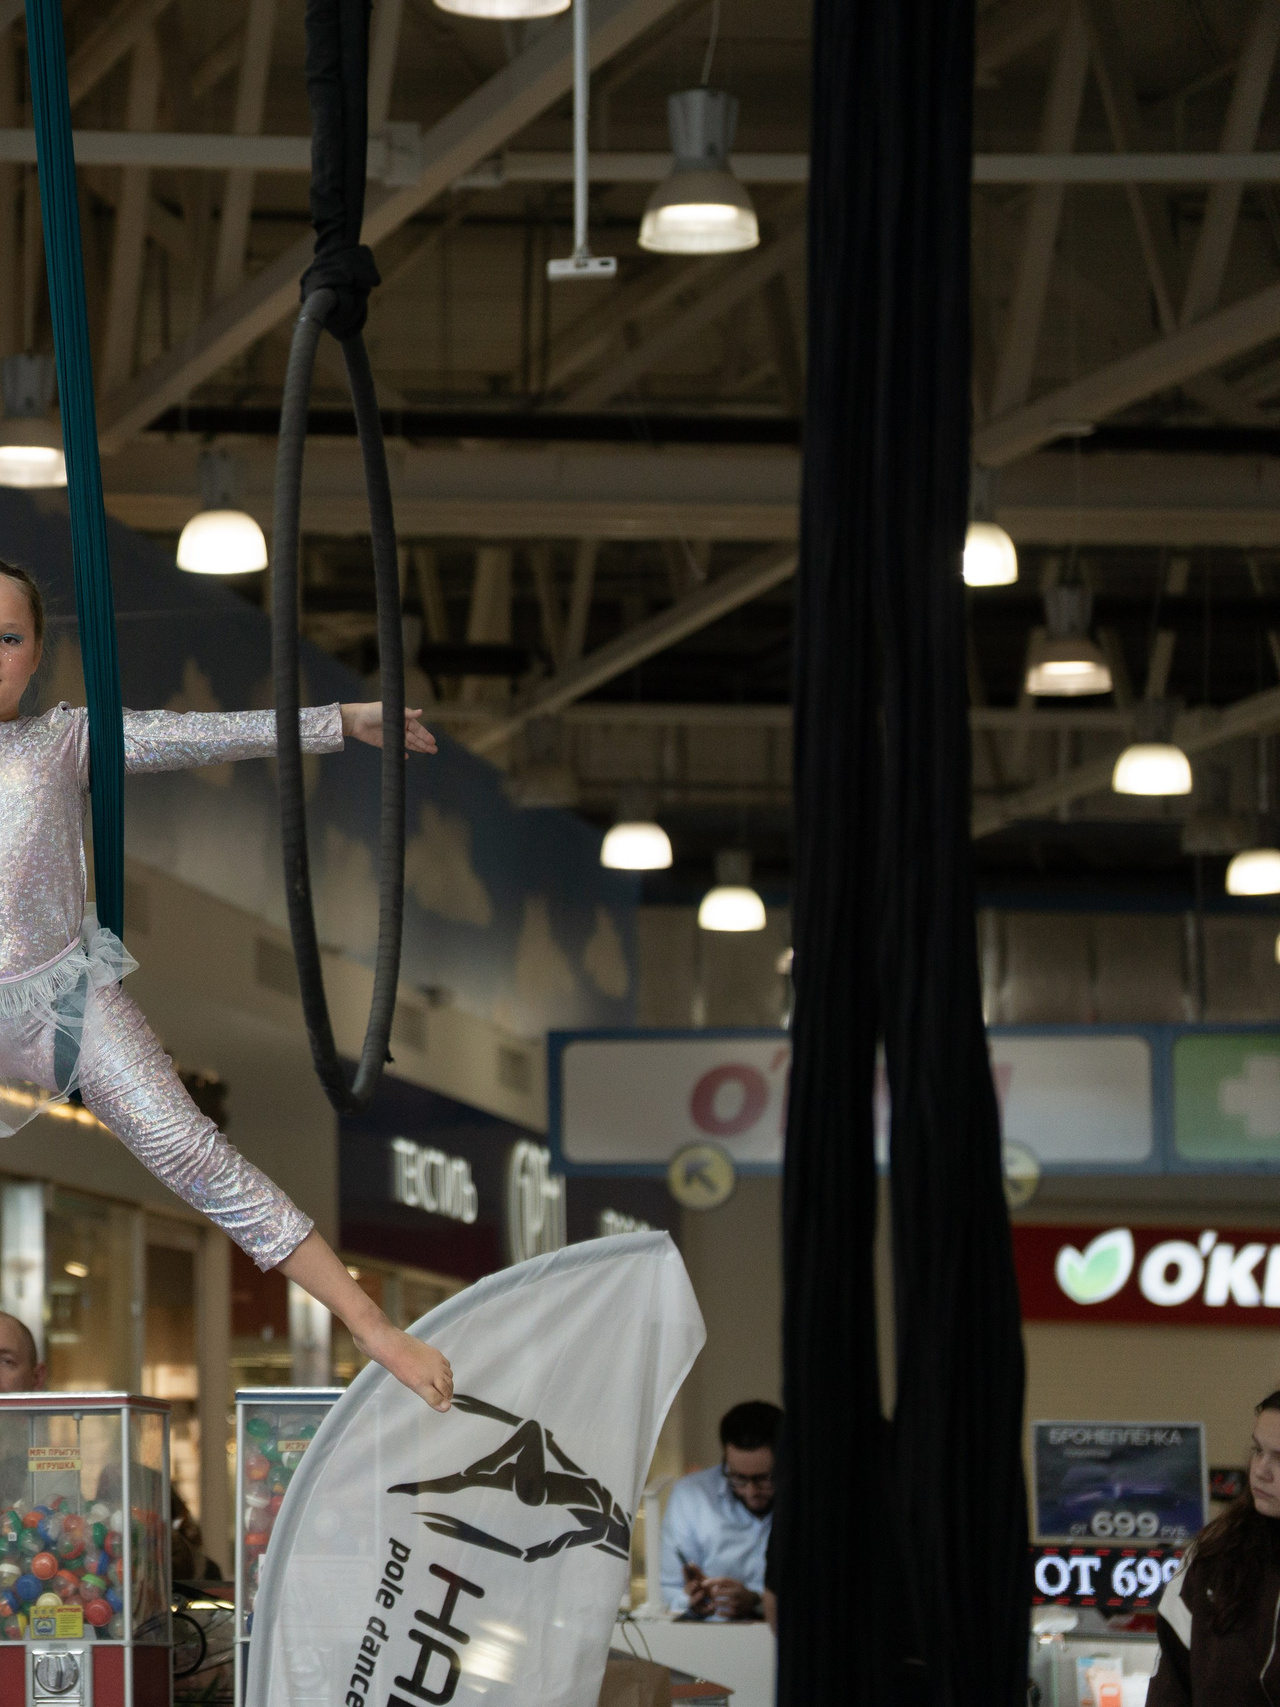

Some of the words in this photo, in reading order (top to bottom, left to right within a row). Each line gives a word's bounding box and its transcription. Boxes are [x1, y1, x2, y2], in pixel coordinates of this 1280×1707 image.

[36, 1461, 75, 1470] ИГРУШКА
[1091, 1510, 1159, 1537] 699
[376, 1537, 412, 1610] pole
[1035, 1556, 1101, 1596] ОТ
[345, 1616, 389, 1707] dance
[386, 1563, 485, 1707] HA
